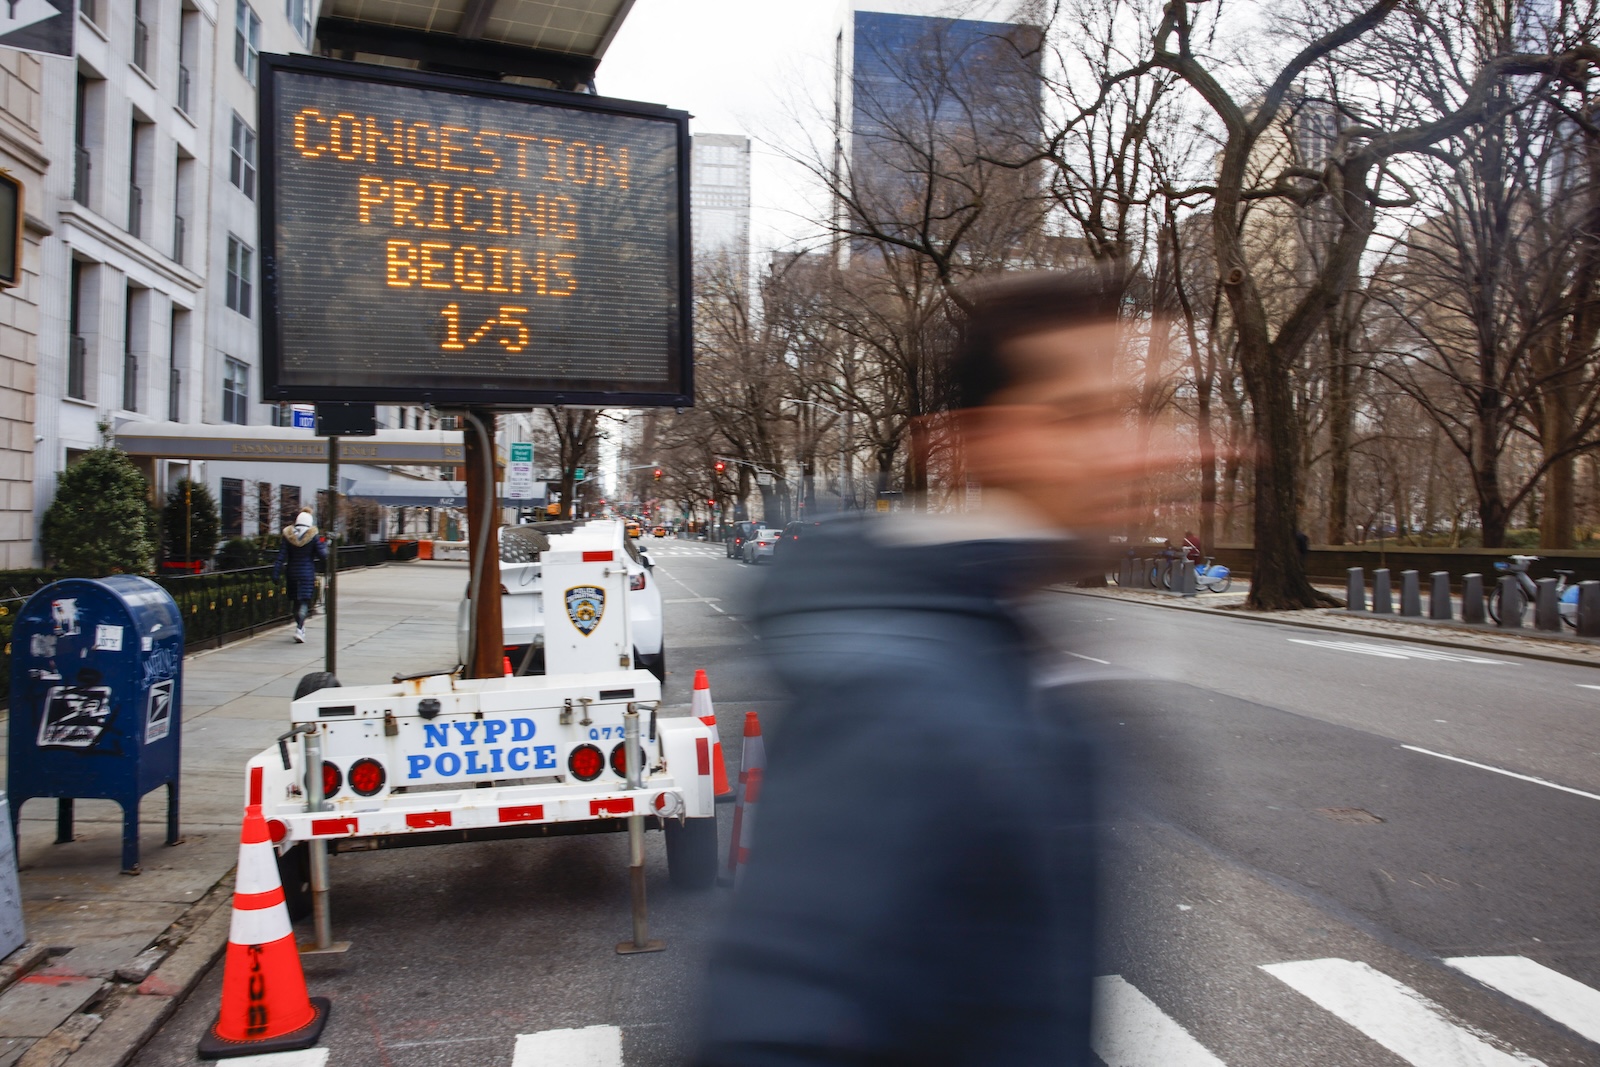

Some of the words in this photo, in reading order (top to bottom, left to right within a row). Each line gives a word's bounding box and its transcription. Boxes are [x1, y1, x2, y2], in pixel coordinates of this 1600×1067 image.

[295, 109, 629, 189] CONGESTION
[359, 177, 576, 240] PRICING
[387, 240, 576, 296] BEGINS
[441, 304, 528, 351] 1/5
[337, 446, 378, 457] ENUE
[423, 717, 536, 748] NYPD
[407, 744, 557, 779] POLICE
